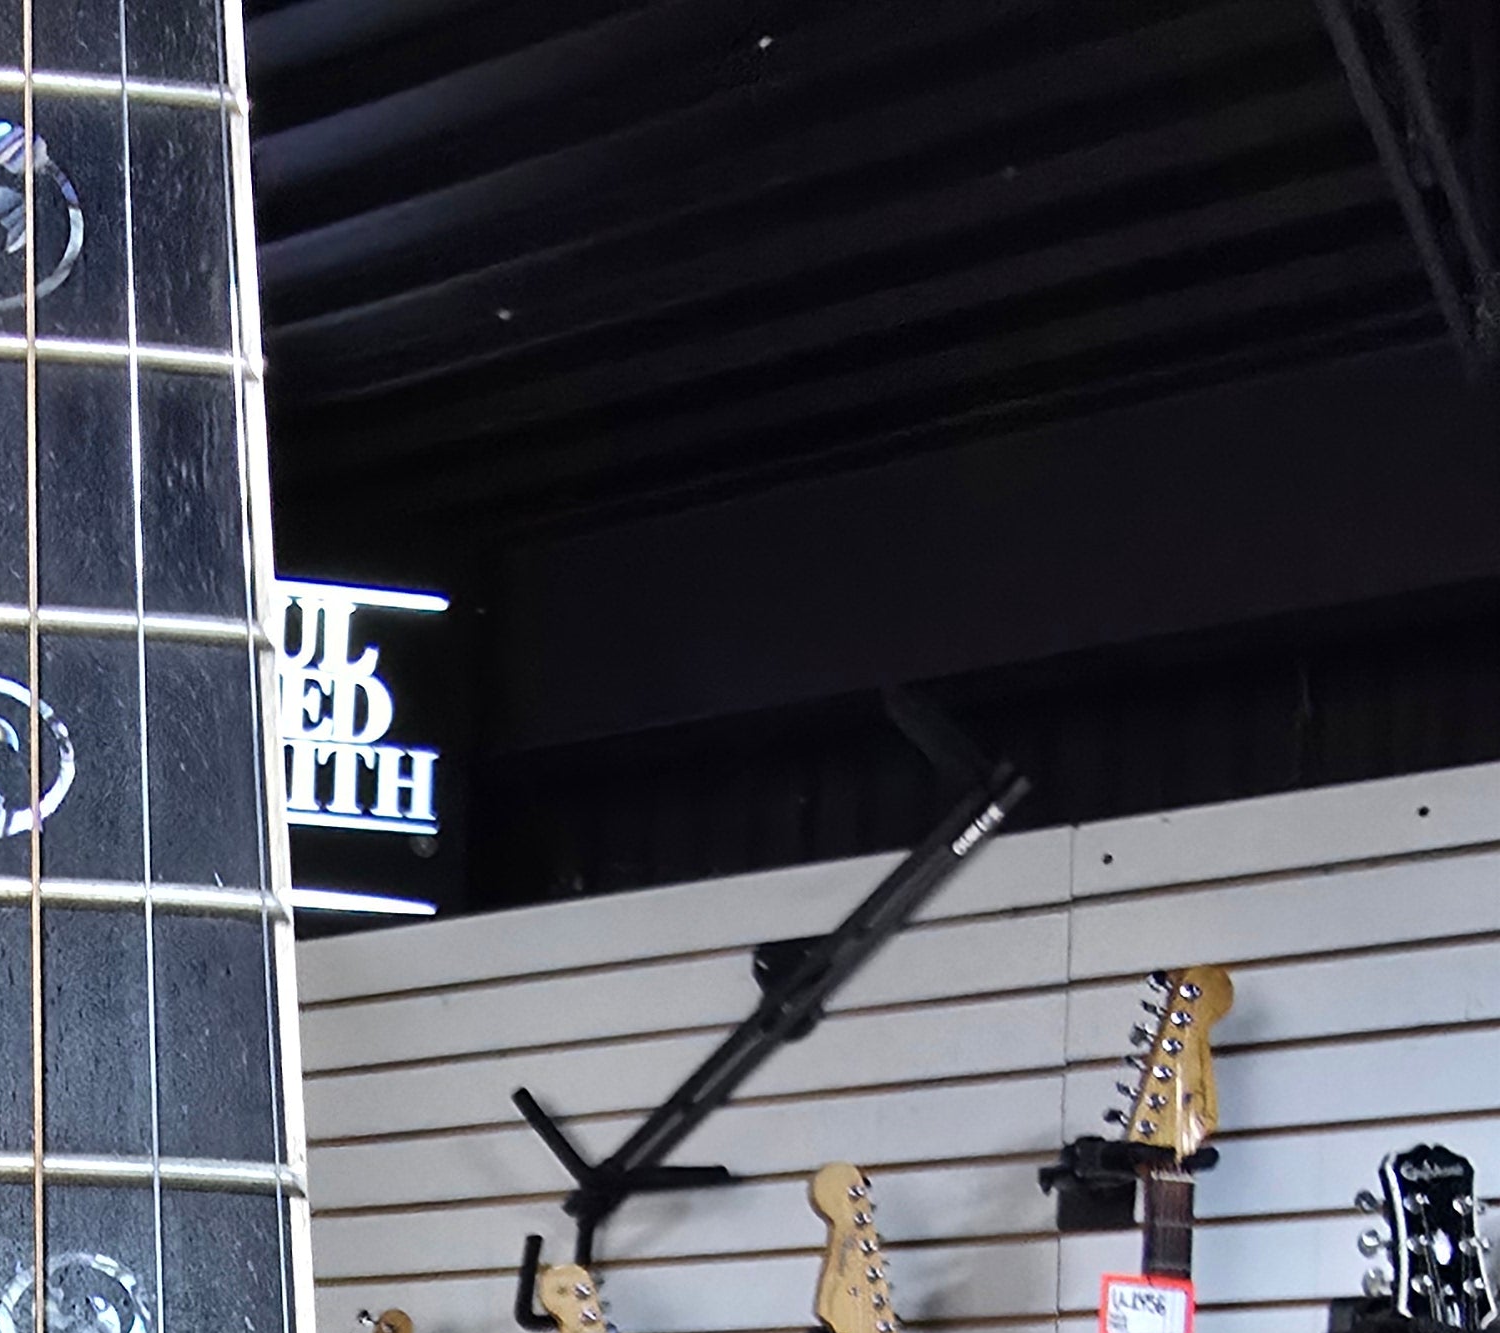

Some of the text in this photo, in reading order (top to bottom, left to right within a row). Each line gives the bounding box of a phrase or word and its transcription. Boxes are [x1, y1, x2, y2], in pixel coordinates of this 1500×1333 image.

[276, 597, 380, 677] UL
[280, 671, 394, 745] ED
[285, 743, 440, 821] ITH
